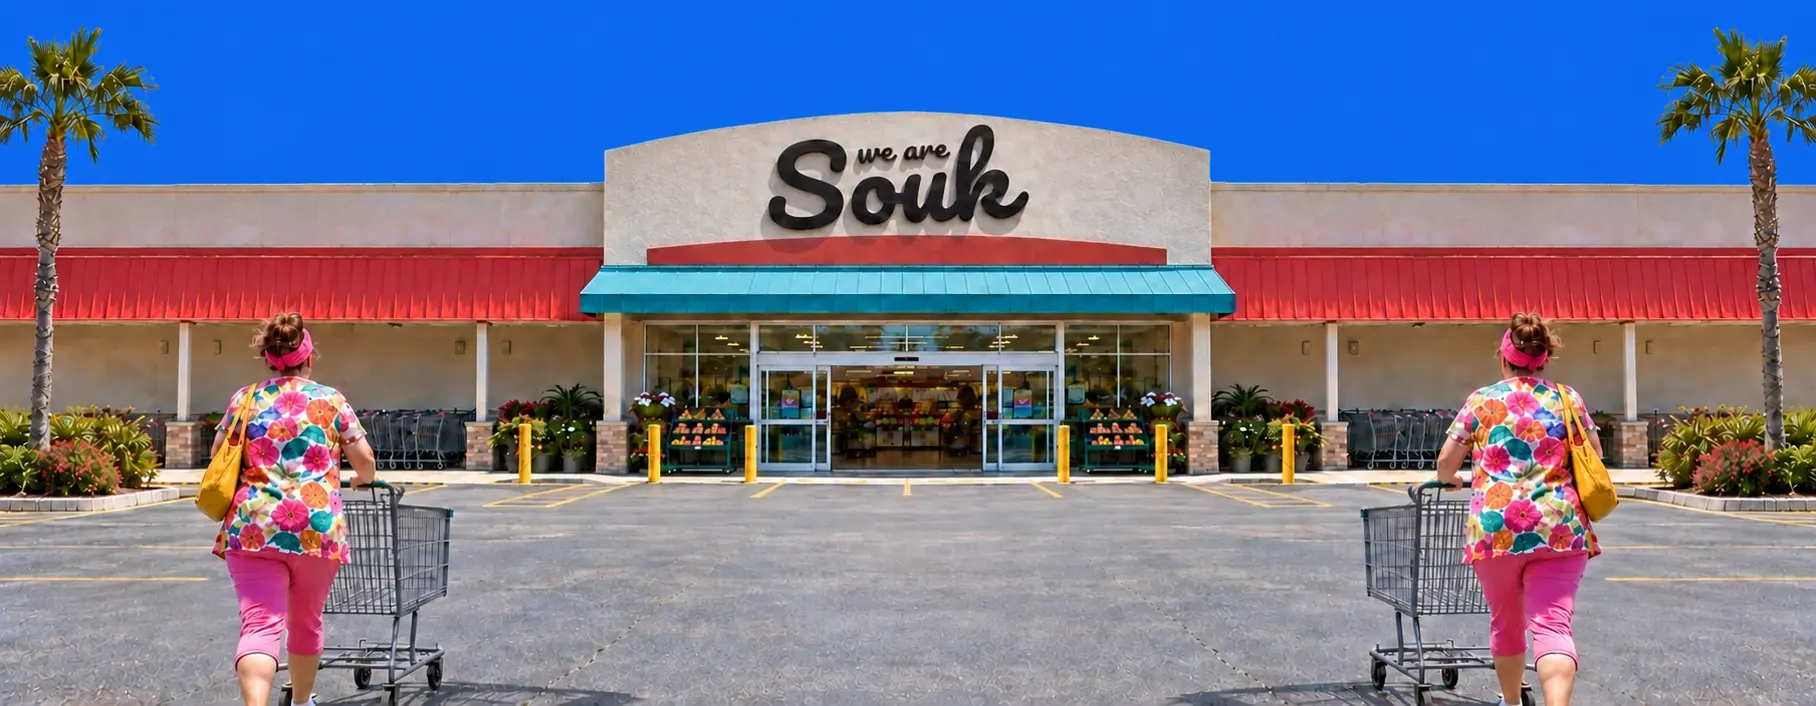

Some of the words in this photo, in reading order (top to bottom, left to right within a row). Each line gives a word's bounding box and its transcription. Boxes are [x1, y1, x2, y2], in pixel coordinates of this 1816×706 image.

[768, 124, 1030, 231] Souk
[857, 147, 898, 165] we
[903, 143, 951, 161] are
